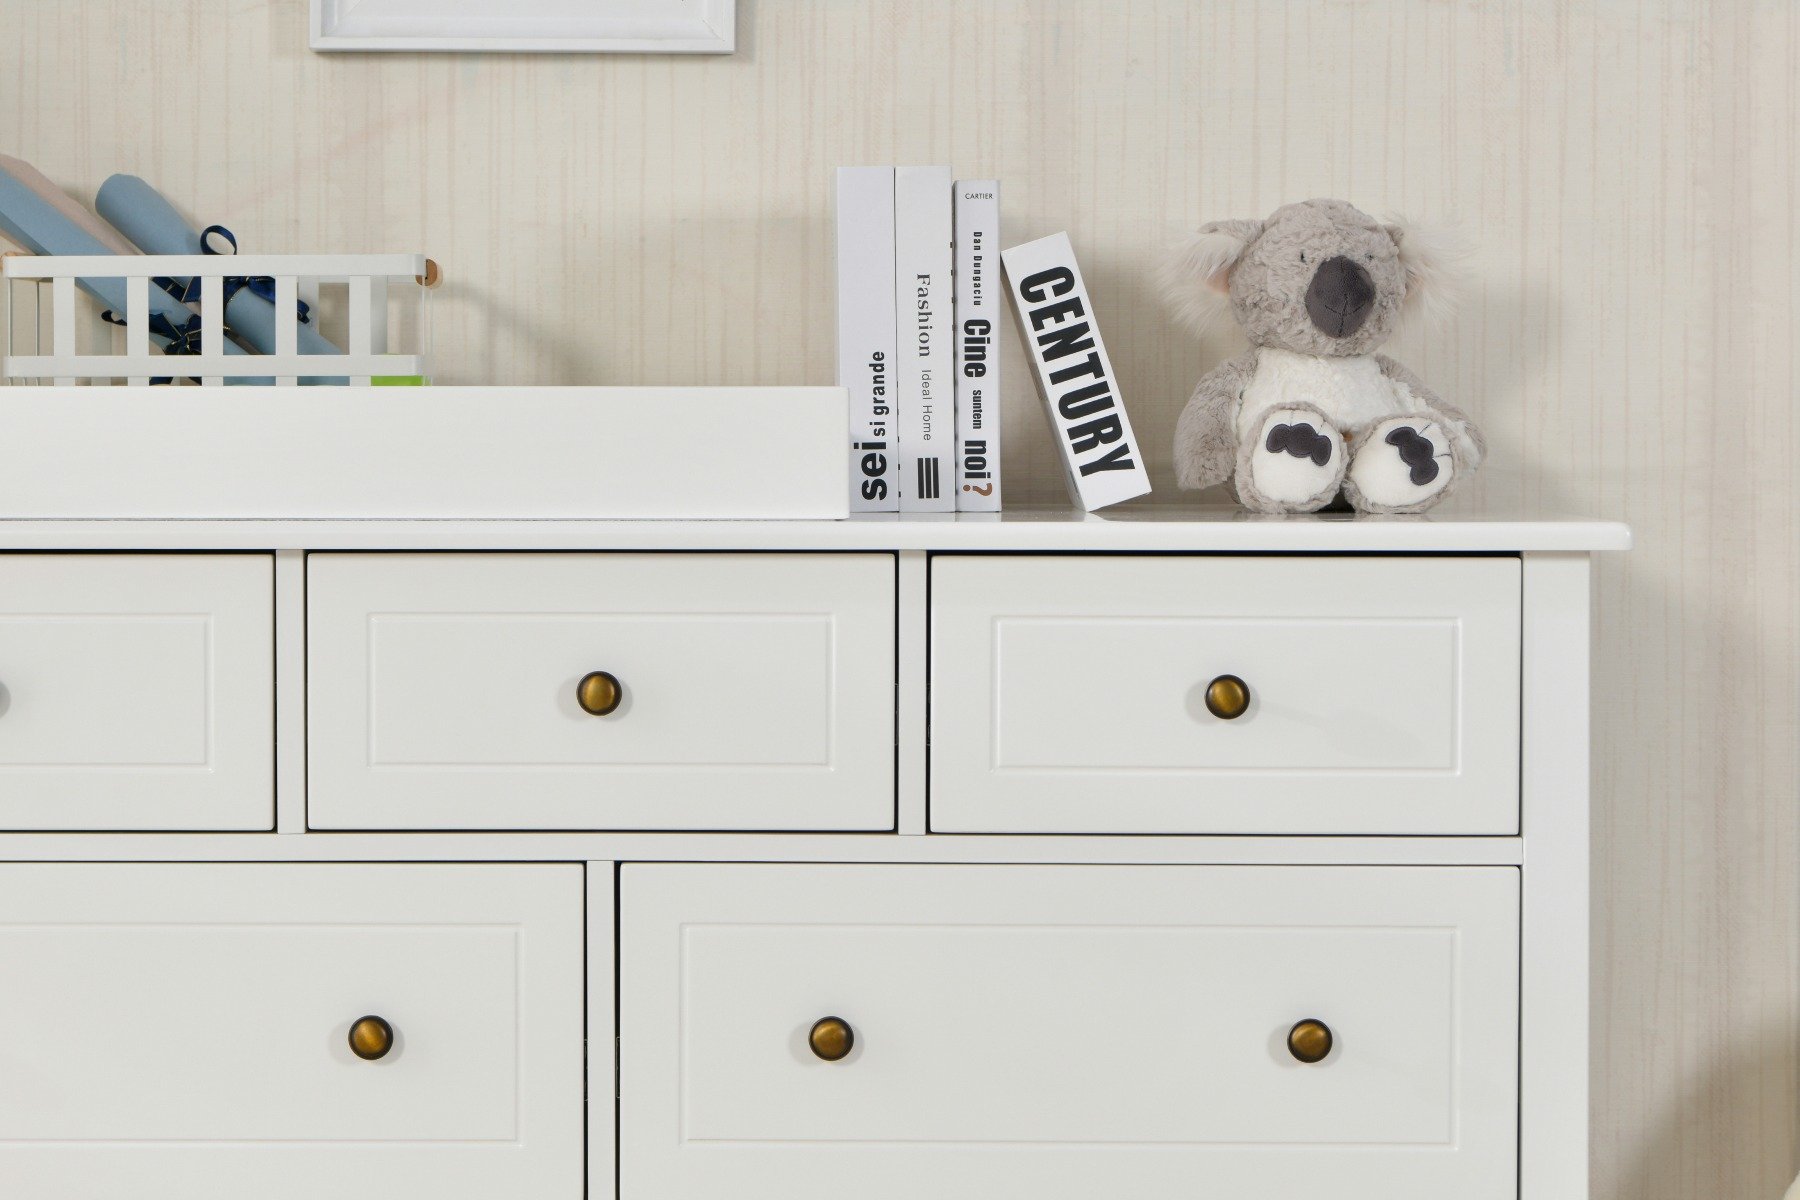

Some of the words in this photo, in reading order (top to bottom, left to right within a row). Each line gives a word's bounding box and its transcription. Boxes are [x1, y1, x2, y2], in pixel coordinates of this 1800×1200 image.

[964, 192, 994, 200] CARTIER
[973, 231, 983, 251] Dan
[972, 255, 983, 306] Dungaciu
[916, 273, 933, 357] Fashion
[963, 319, 992, 378] Cine
[1019, 266, 1136, 478] CENTURY
[868, 351, 890, 416] grande
[921, 369, 933, 400] Ideal
[869, 421, 886, 437] si
[922, 405, 933, 441] Home
[972, 389, 983, 430] suntem
[853, 441, 888, 501] sei
[962, 440, 993, 497] noi?
